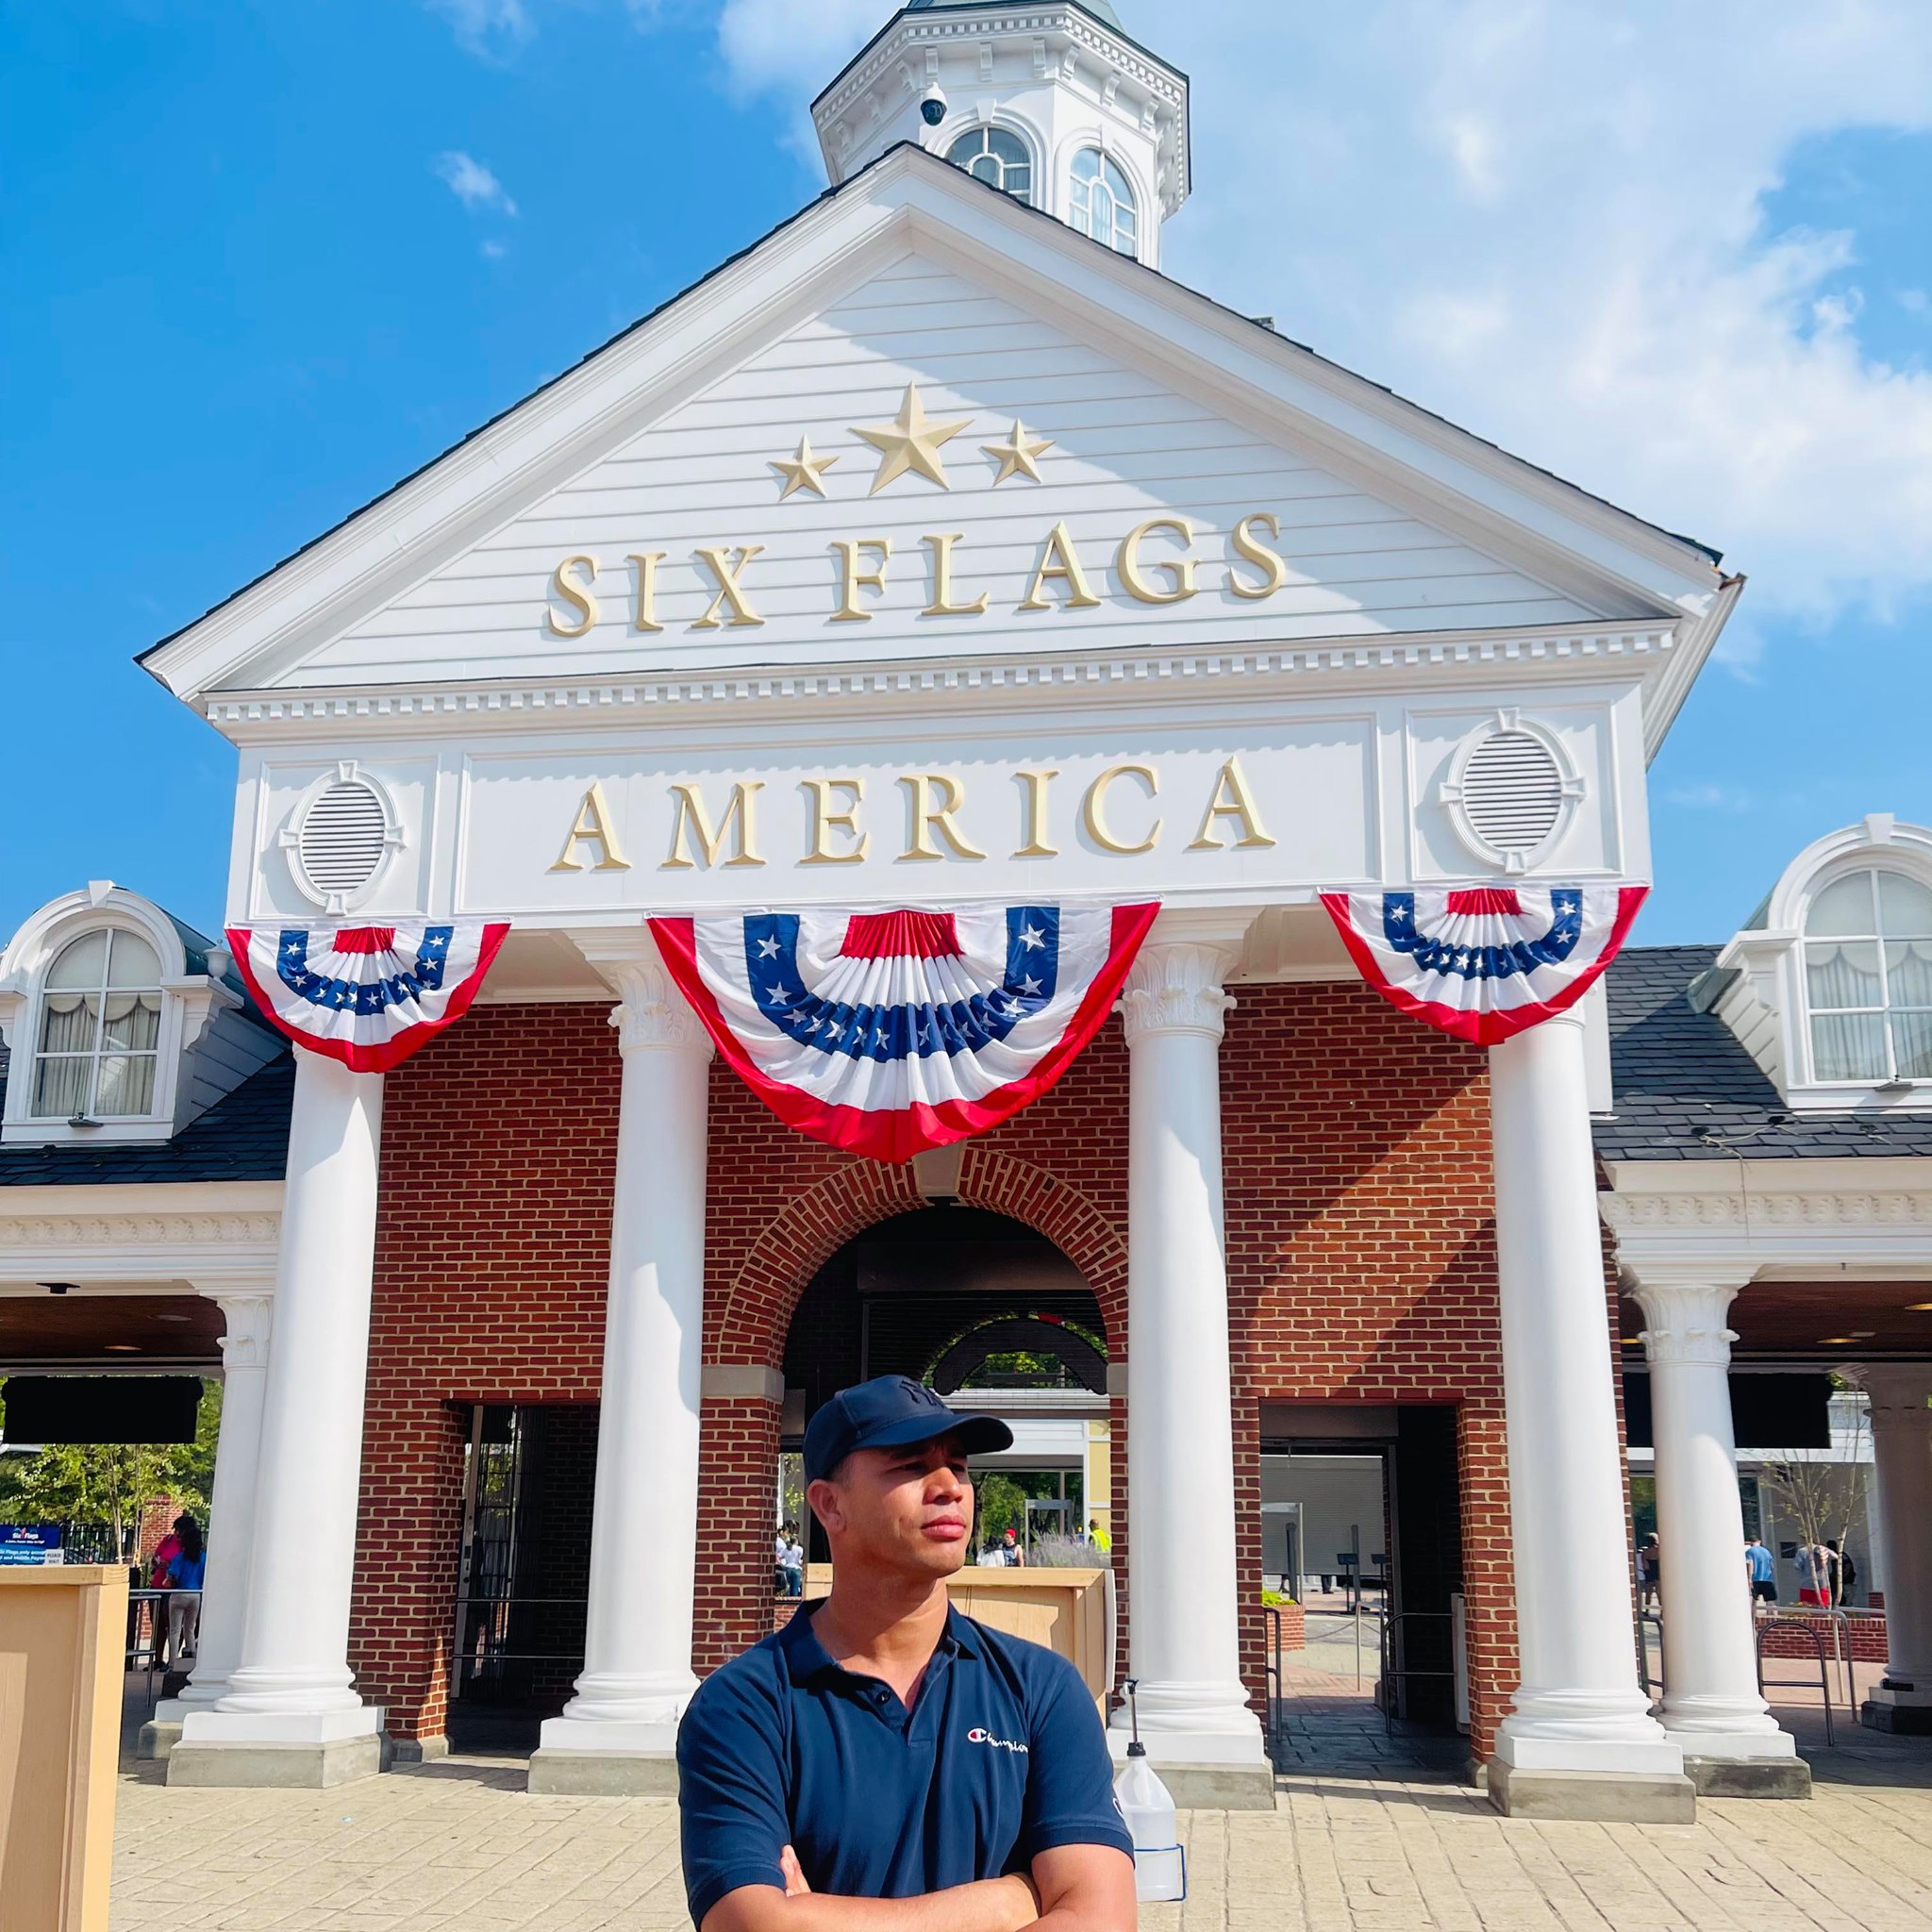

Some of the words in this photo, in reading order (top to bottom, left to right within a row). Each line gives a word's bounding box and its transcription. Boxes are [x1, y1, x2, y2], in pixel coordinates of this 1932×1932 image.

[548, 544, 766, 638] SIX
[829, 512, 1287, 623] FLAGS
[549, 755, 1277, 872] AMERICA
